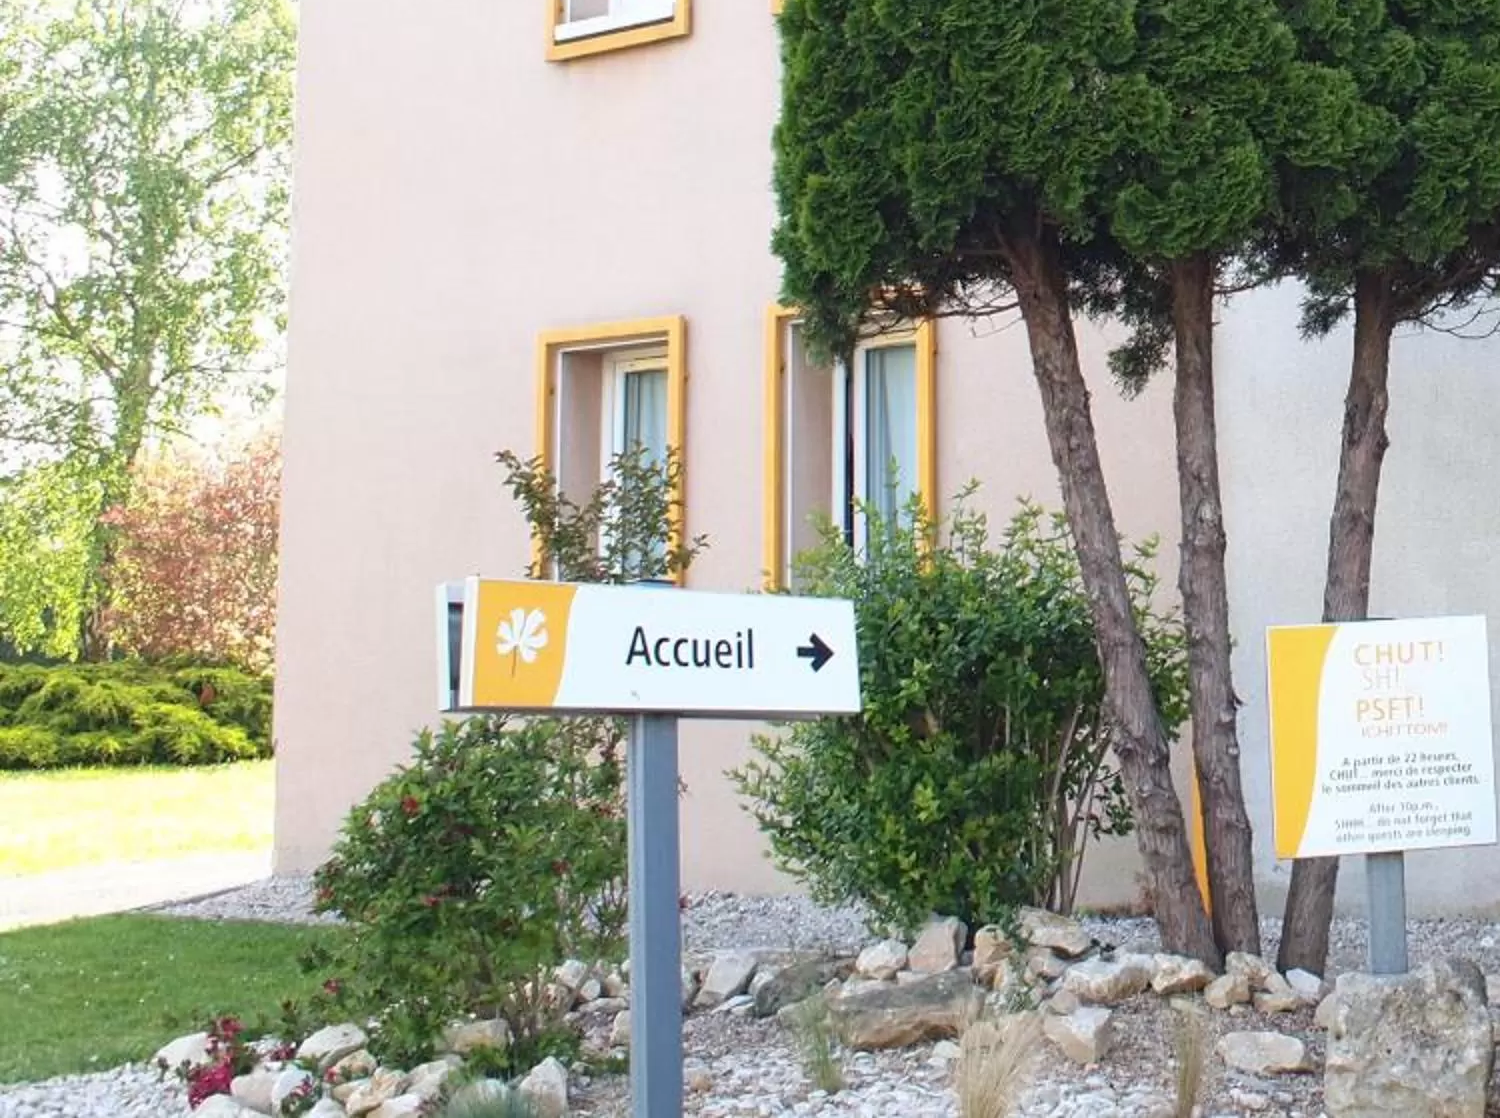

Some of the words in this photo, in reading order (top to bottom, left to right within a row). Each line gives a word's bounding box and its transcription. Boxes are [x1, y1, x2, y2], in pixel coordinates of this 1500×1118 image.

[626, 626, 754, 669] Accueil
[1353, 641, 1444, 666] CHUT!
[1362, 665, 1400, 690] SH!
[1356, 696, 1424, 722] PSFT!
[1354, 754, 1383, 770] partir
[1388, 753, 1401, 764] de
[1404, 752, 1417, 763] 22
[1371, 768, 1403, 779] merci
[1406, 766, 1418, 776] de
[1421, 763, 1472, 776] respecter
[1322, 783, 1332, 794] le
[1336, 780, 1380, 792] sommeil
[1383, 779, 1403, 790] des
[1407, 777, 1440, 789] autres
[1394, 815, 1411, 824] not
[1415, 813, 1447, 826] forget
[1451, 811, 1472, 821] that
[1336, 832, 1364, 843] other
[1405, 829, 1424, 839] are
